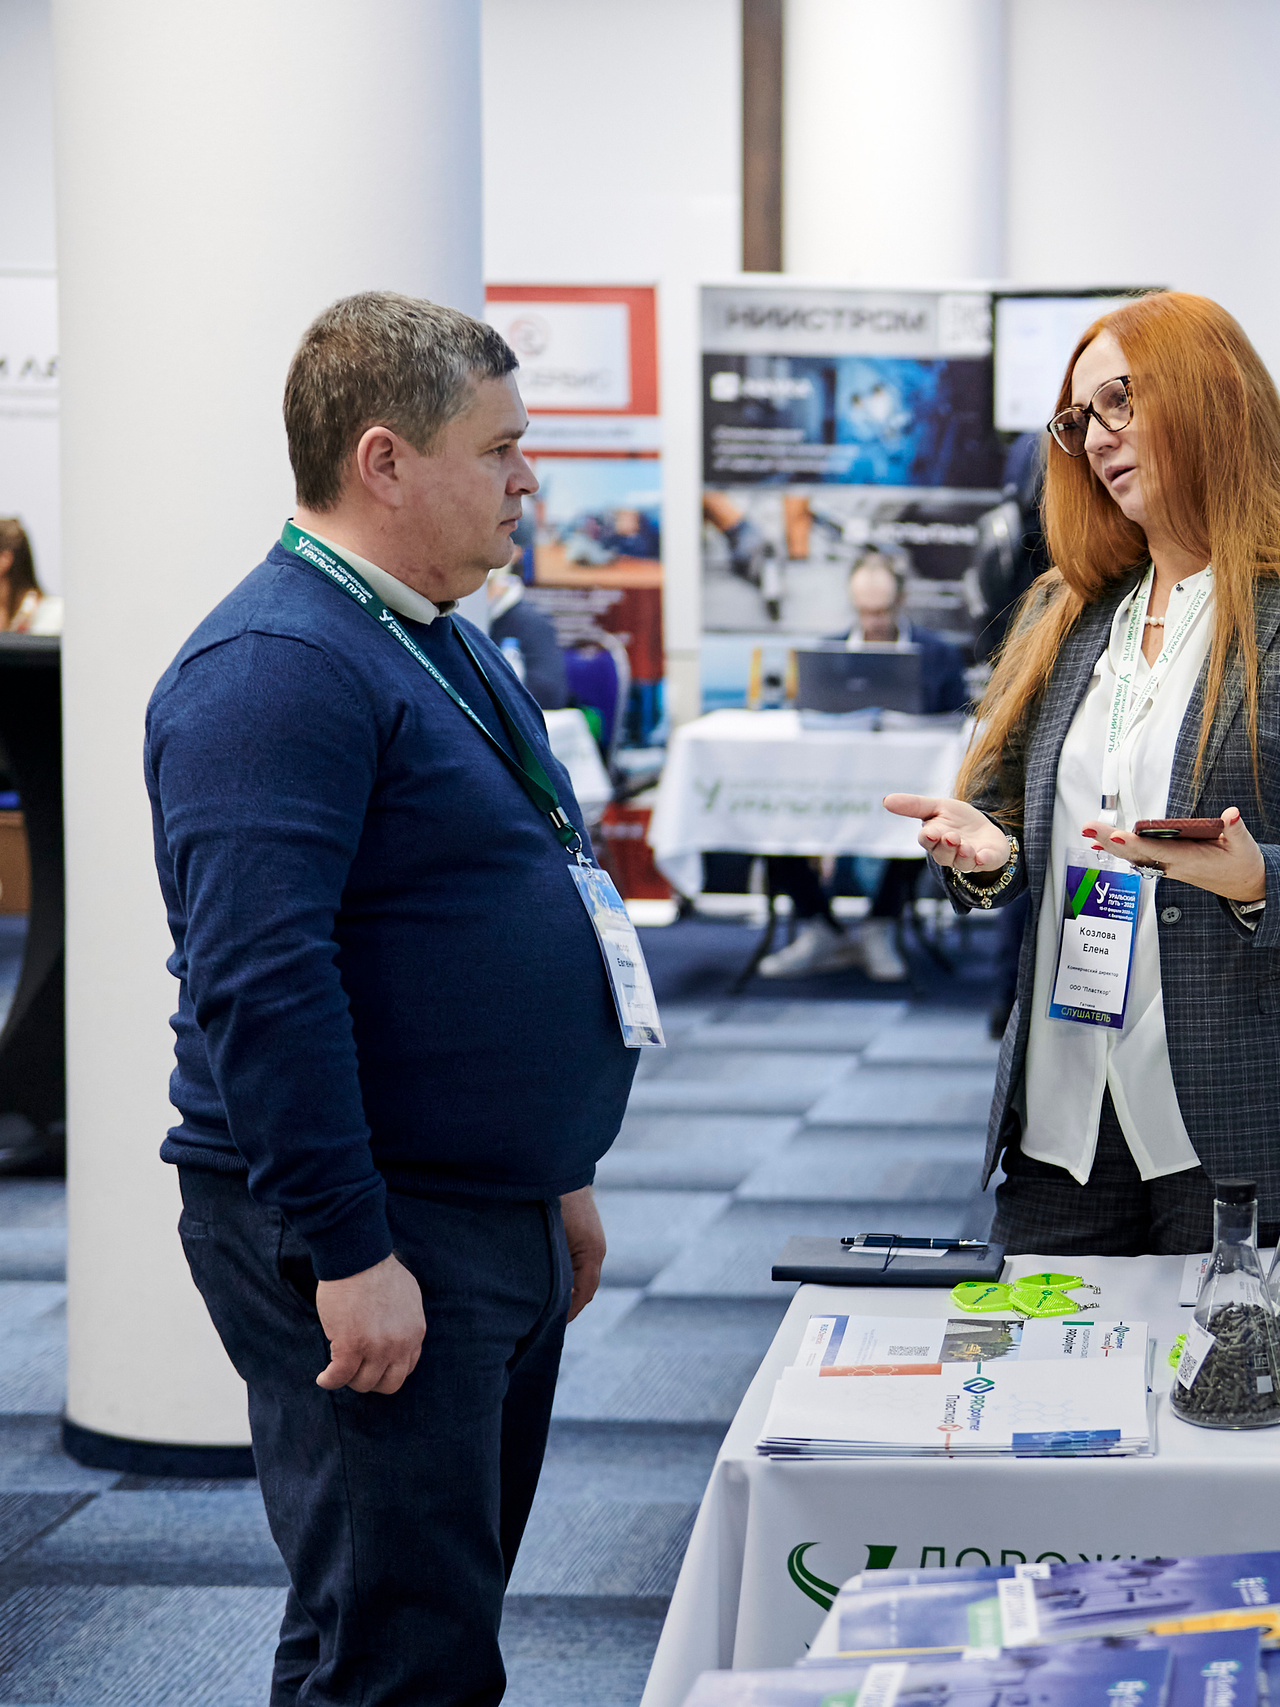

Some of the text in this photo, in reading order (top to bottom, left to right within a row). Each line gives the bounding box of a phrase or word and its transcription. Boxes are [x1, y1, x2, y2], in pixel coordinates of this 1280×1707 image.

[301, 547, 368, 604] УРАЛЬСКИЙ ПУТЬ
[1122, 601, 1140, 662] УРАЛЬСКИЙ ПУТЬ
[1167, 590, 1207, 656] УРАЛЬСКИЙ ПУТЬ
[1107, 683, 1124, 753] УРАЛЬСКИЙ ПУТЬ
[1079, 926, 1117, 941] Козлова
[1082, 943, 1110, 956] Елена
[1069, 983, 1082, 991] ООО
[1060, 1007, 1112, 1023] СЛУШАТЕЛЬ
[1062, 1328, 1077, 1355] PROpolymer
[939, 1394, 961, 1425] Пласткор
[966, 1394, 986, 1432] PROpolymer
